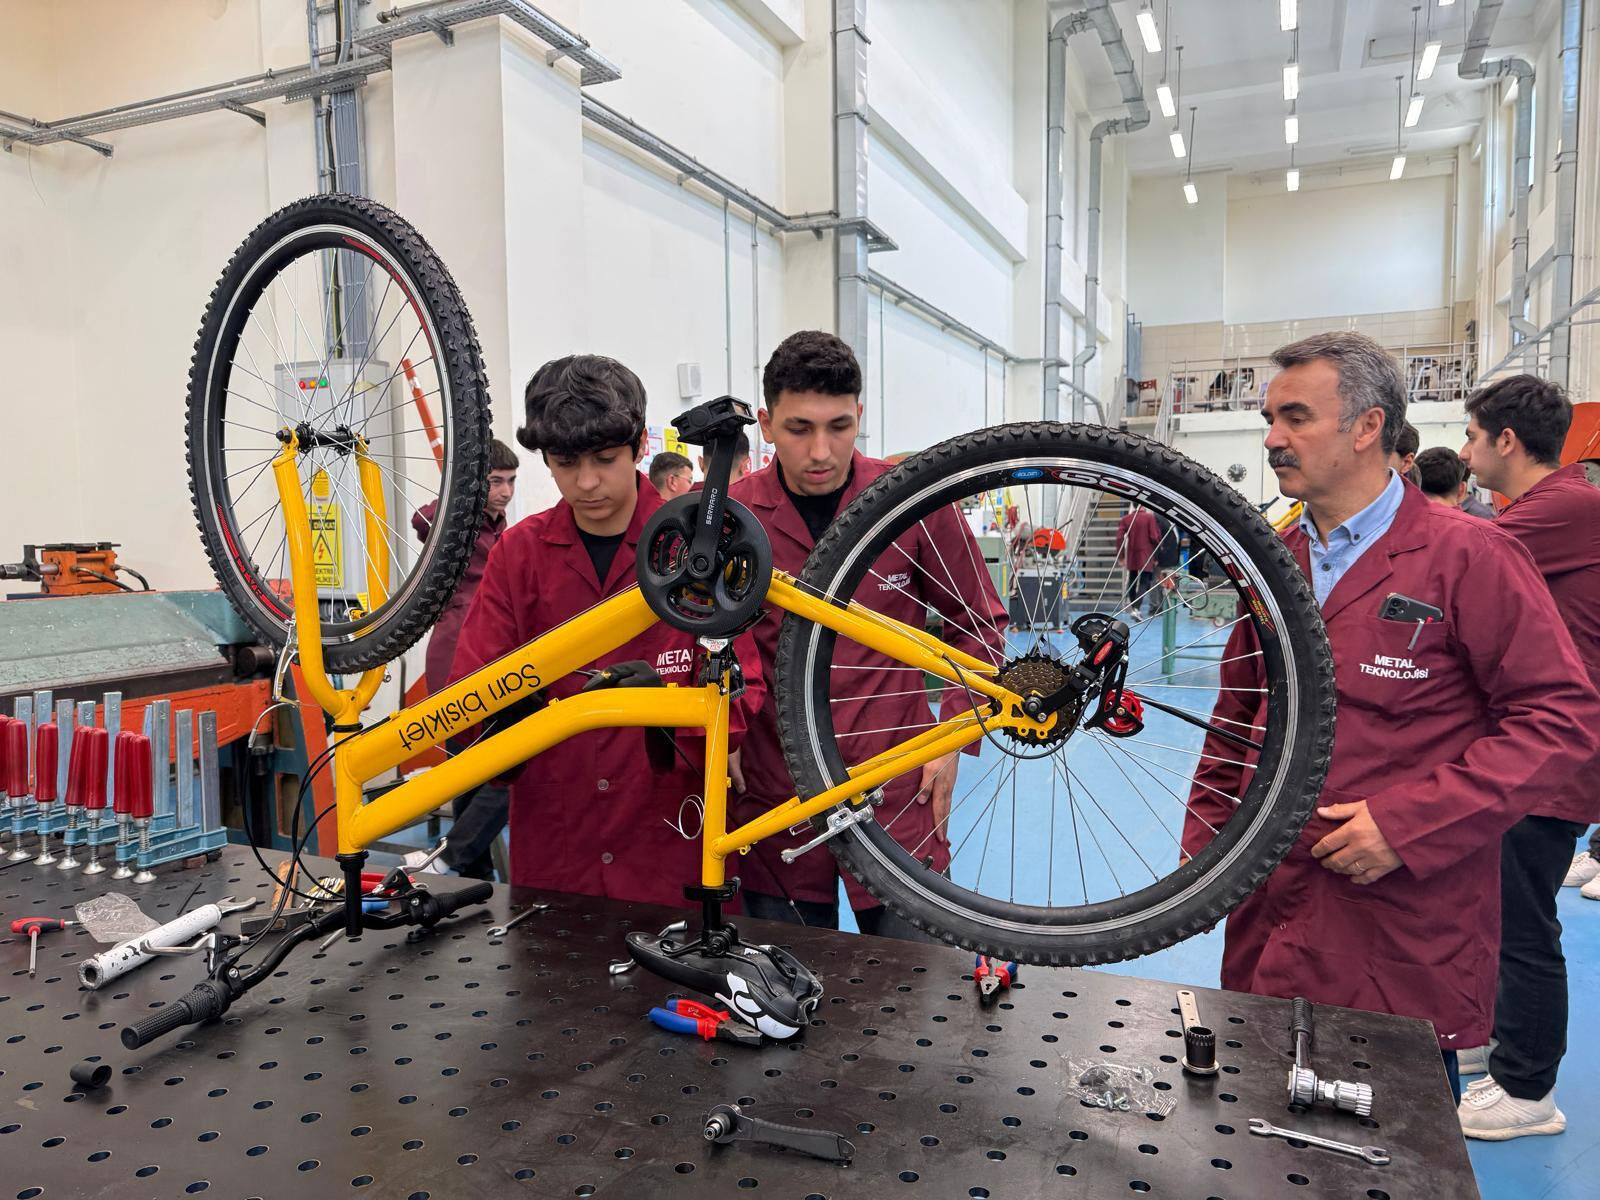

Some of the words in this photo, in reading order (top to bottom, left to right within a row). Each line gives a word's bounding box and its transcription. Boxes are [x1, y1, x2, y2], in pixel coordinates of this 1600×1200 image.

[1059, 469, 1250, 589] GOLDEN
[1359, 662, 1429, 680] TEKNOLOJİSİ
[1374, 654, 1416, 669] METAL
[487, 663, 542, 701] Sarı
[398, 689, 488, 751] bisiklet
